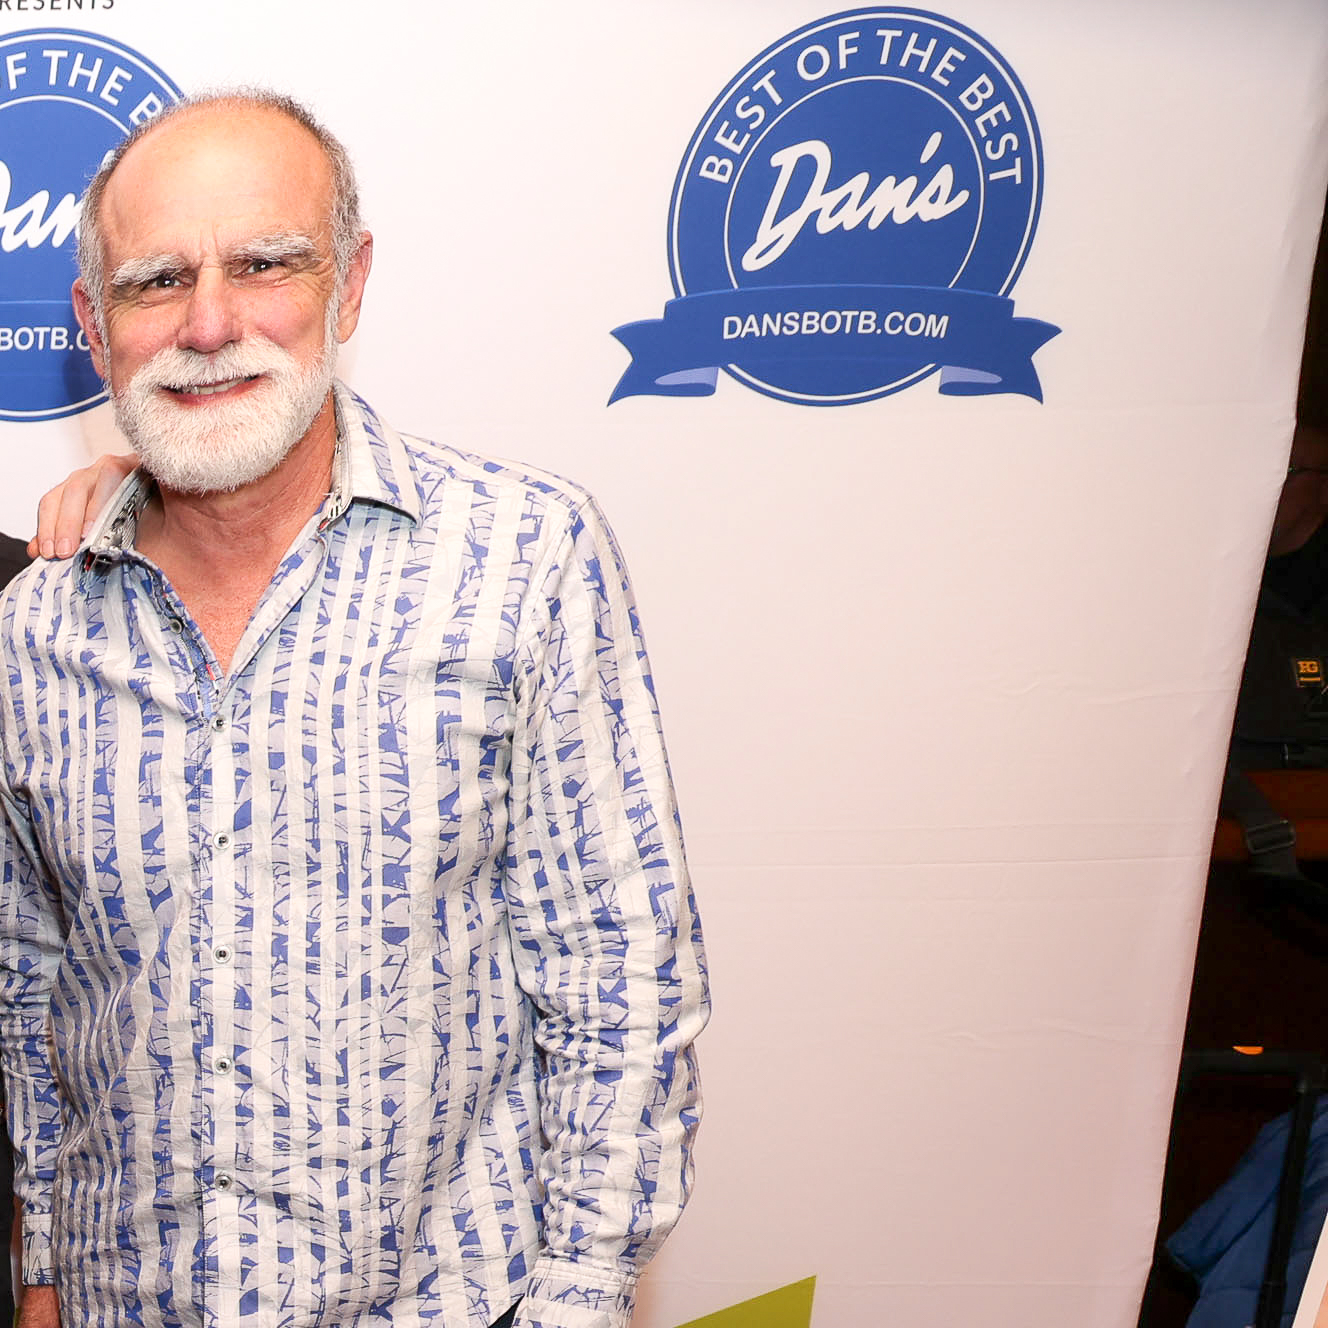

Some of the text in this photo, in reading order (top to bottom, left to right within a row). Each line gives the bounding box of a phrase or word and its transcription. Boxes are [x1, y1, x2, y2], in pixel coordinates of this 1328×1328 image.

[42, 49, 132, 106] THE
[698, 29, 1022, 185] BEST OF THE BEST
[741, 131, 971, 271] Dan's
[723, 310, 949, 340] DANSBOTB.COM
